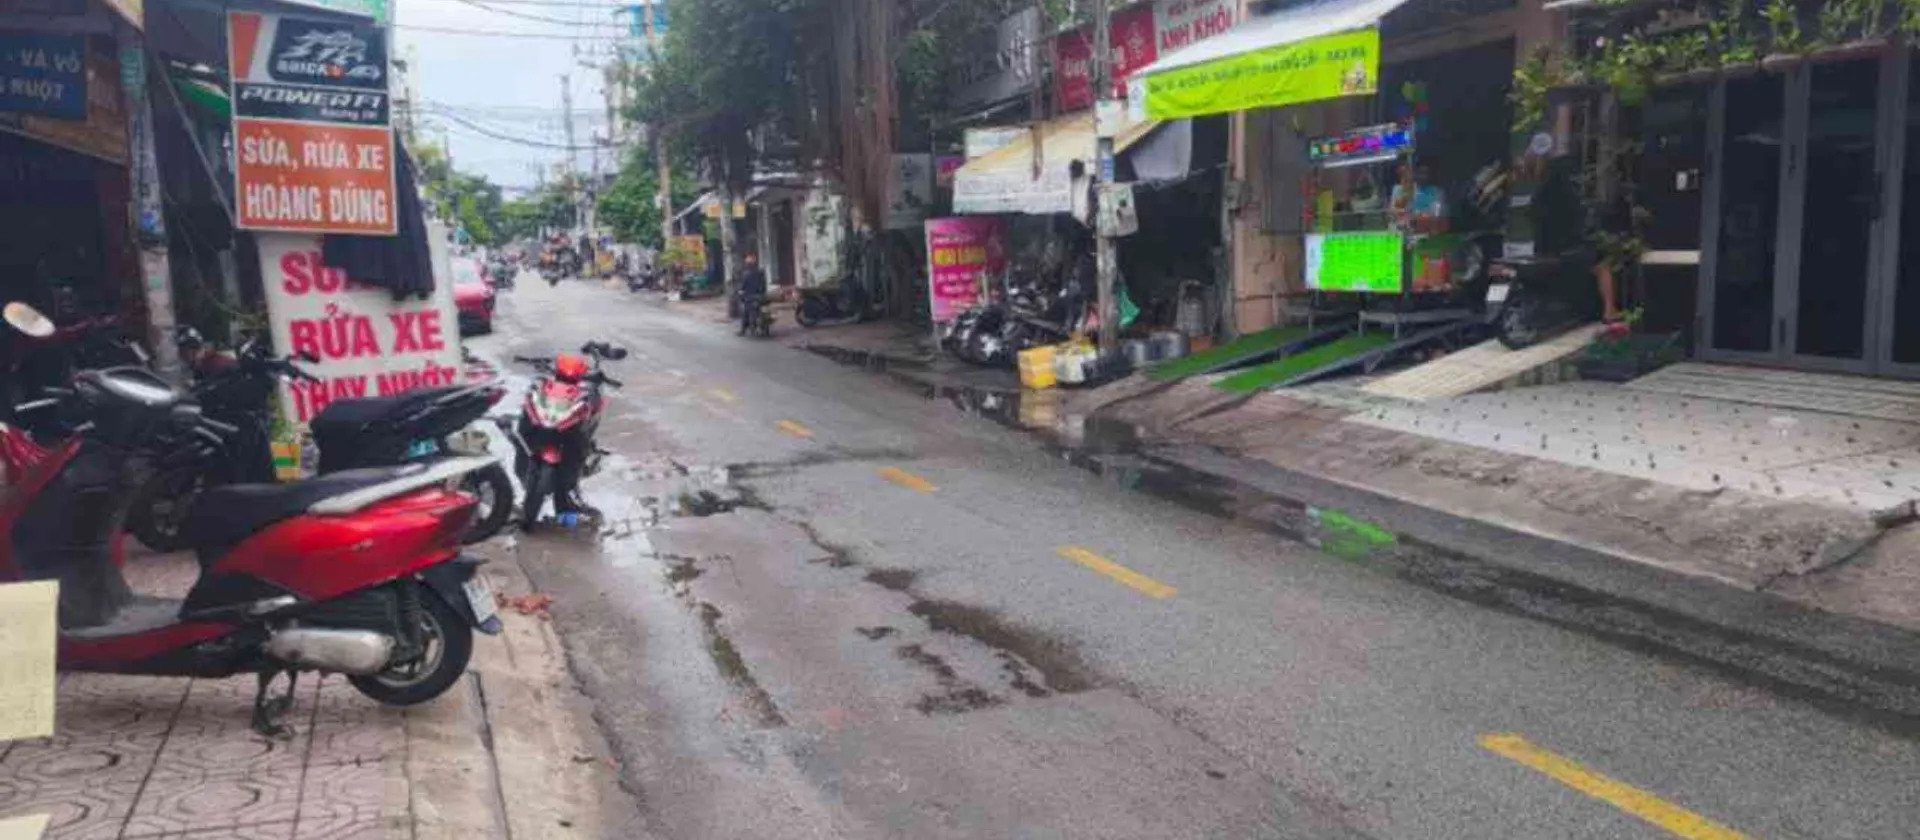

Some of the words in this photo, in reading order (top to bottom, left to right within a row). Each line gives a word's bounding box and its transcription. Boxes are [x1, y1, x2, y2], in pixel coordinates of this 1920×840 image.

[243, 127, 299, 172] SỬA,
[303, 131, 350, 169] RỬA
[356, 143, 385, 171] XE
[245, 174, 323, 222] HOÀNG
[289, 302, 380, 361] RỬA
[390, 309, 445, 354] XE
